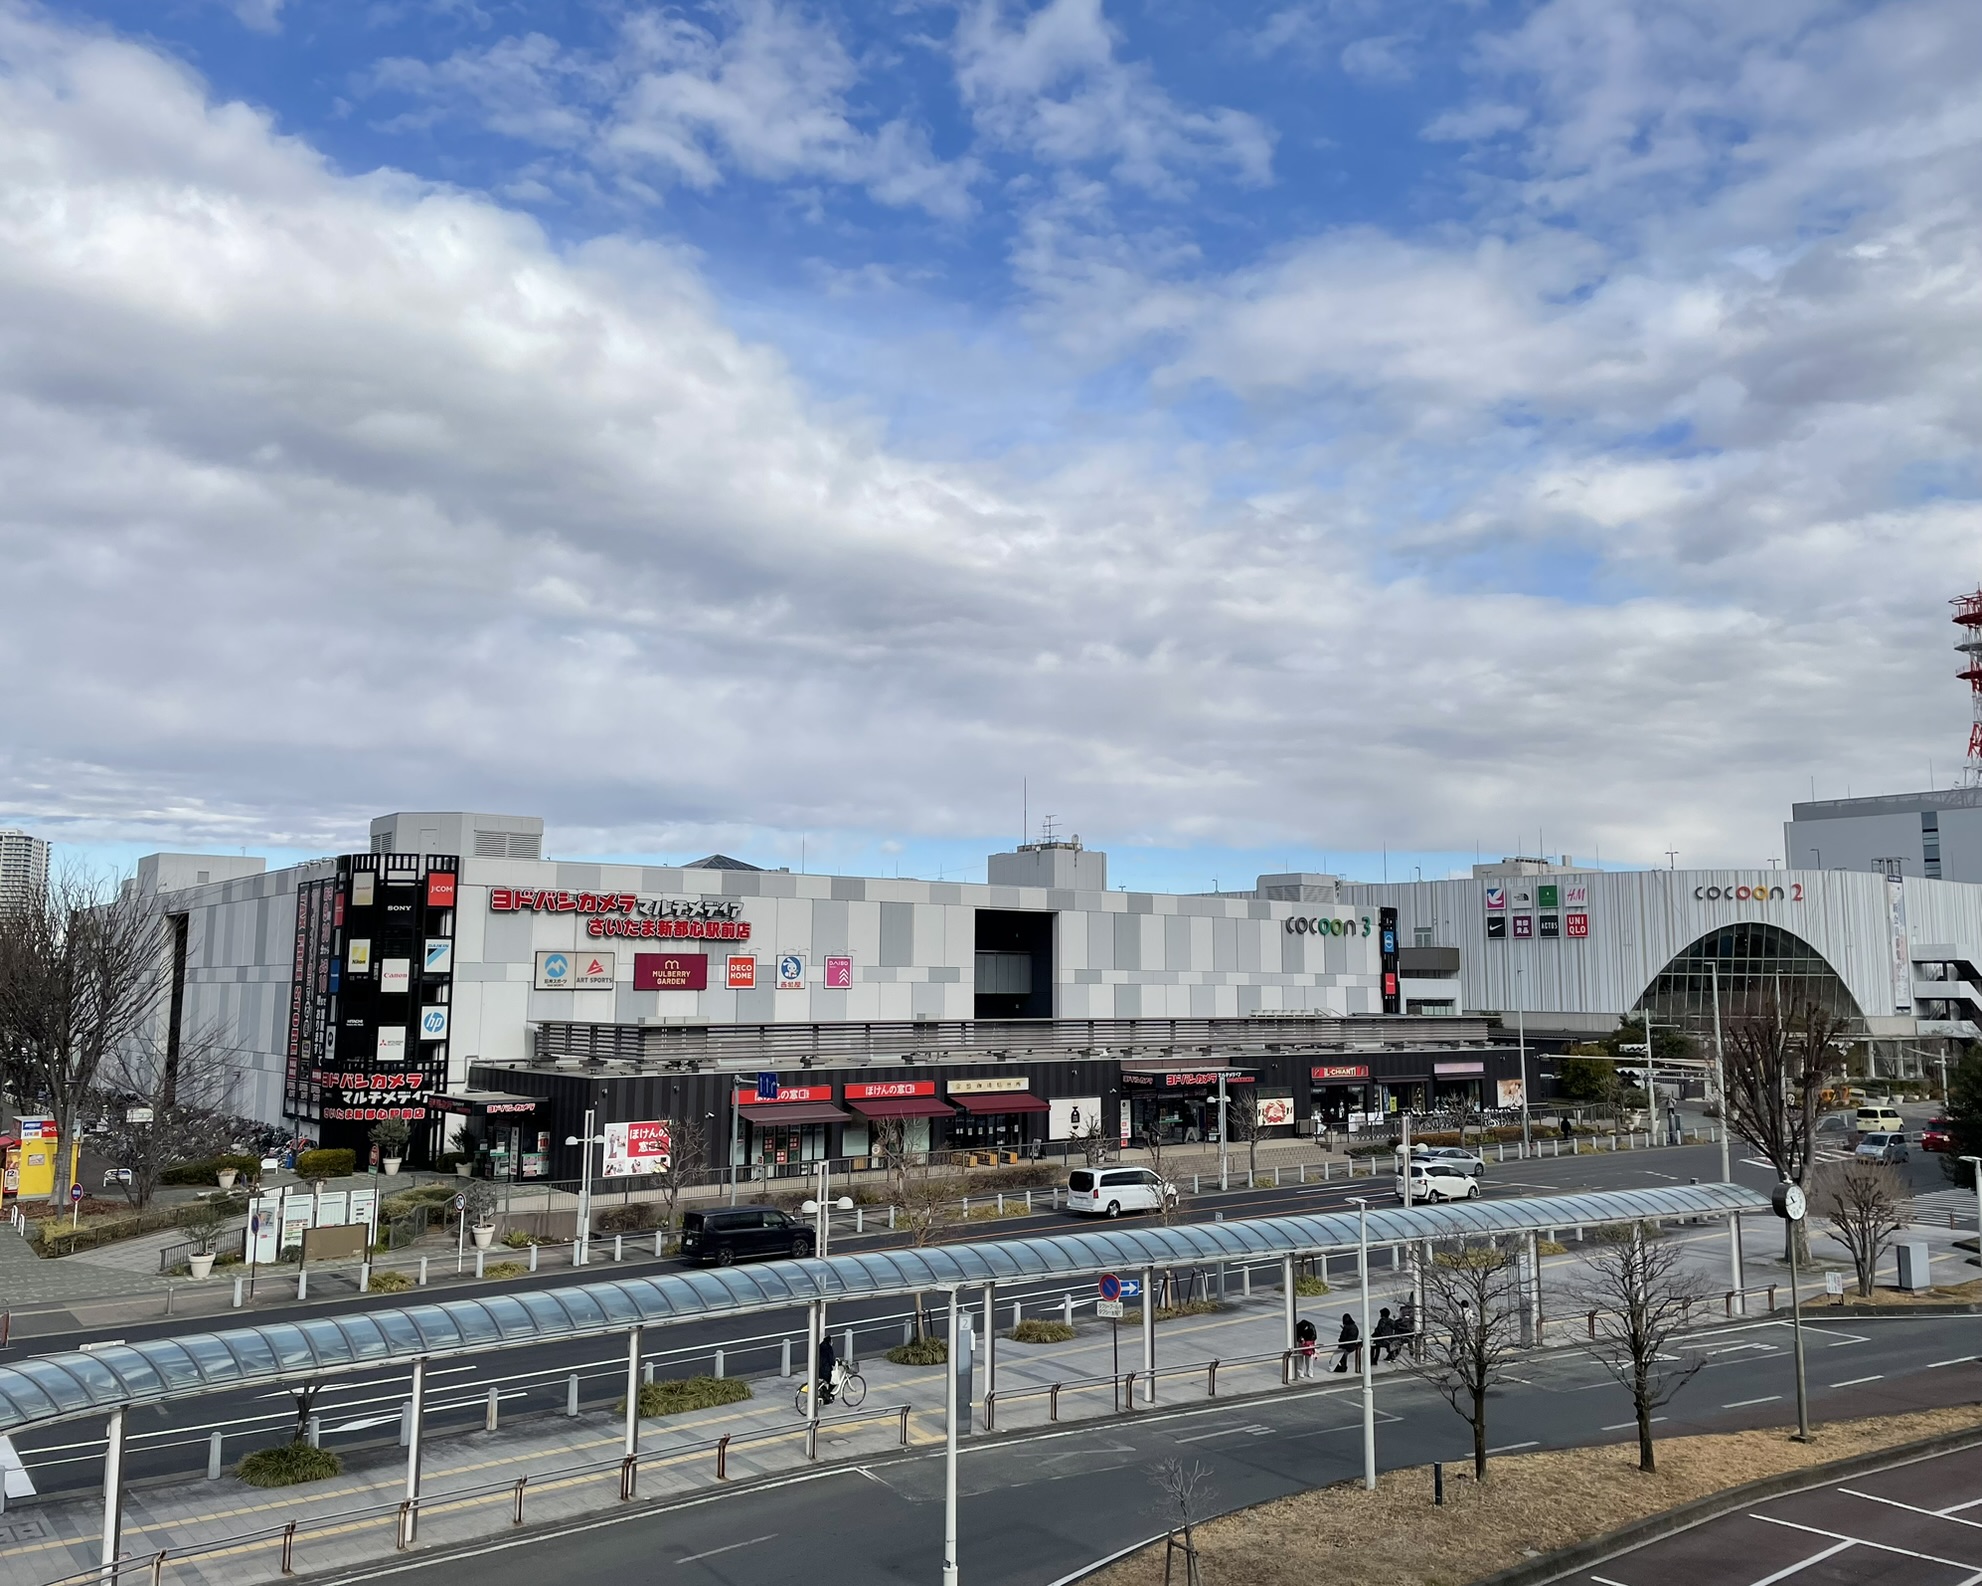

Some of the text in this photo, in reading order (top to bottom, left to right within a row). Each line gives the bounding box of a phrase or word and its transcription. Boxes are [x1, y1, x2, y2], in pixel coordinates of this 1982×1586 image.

[1567, 888, 1585, 901] H&M
[1694, 883, 1804, 902] cocoon 2
[387, 904, 412, 912] SONY
[491, 888, 745, 918] ヨドバシカメラ マルチメディア
[1285, 915, 1371, 938] cocoon 3
[1541, 921, 1558, 930] ACTUS
[1569, 917, 1584, 925] UNI
[588, 916, 752, 941] さいたま新都心駅前店
[1569, 926, 1586, 934] QLO
[294, 933, 306, 982] FREE
[652, 970, 691, 978] MULBERRY
[730, 964, 753, 972] DECO
[289, 985, 302, 1056] STORE
[321, 1071, 424, 1089] ヨドバシカメラ
[1165, 1072, 1218, 1086] ヨドバシカメラ
[865, 1083, 914, 1096] ほけんの窓口
[341, 1090, 436, 1105] マルチメディア
